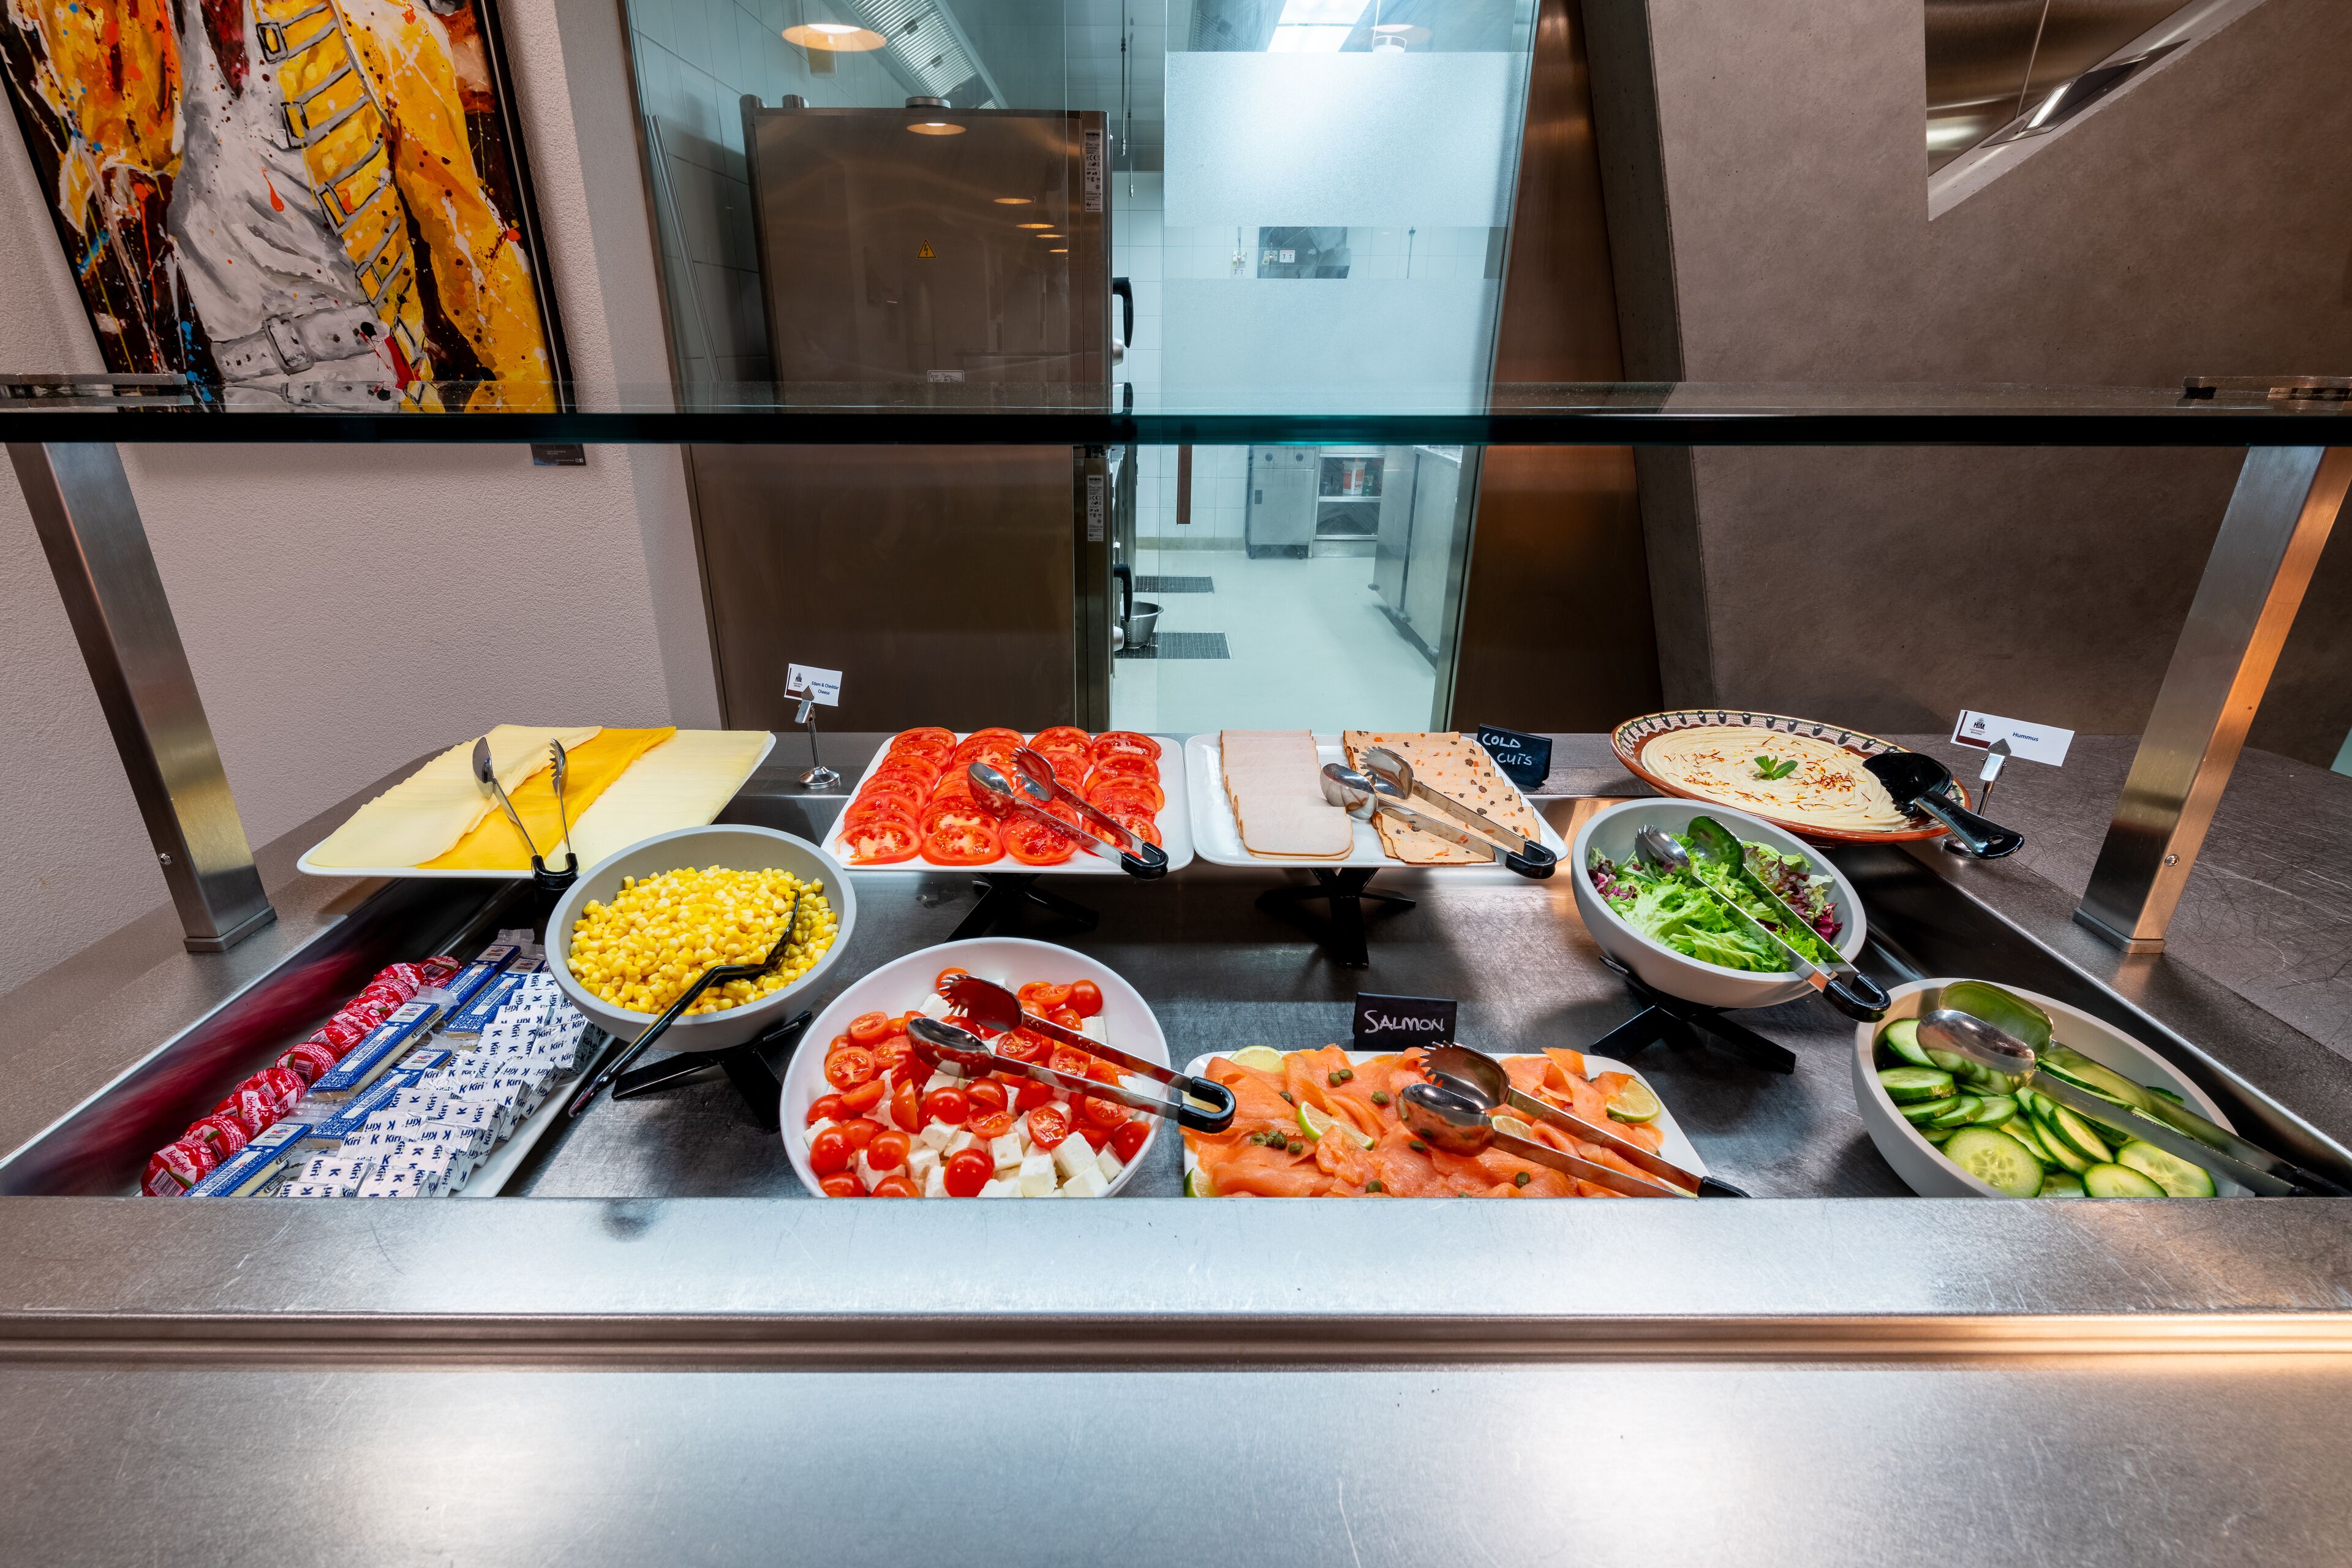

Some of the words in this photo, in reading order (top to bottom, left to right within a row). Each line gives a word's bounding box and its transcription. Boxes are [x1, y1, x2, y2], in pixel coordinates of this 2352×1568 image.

[1482, 733, 1521, 748] COLD
[2013, 732, 2039, 742] Hummus
[398, 965, 418, 986] Babybel
[1364, 1009, 1445, 1033] SALMON
[511, 1024, 521, 1038] Kiri
[490, 1042, 500, 1055] Kiri
[550, 1041, 564, 1050] Kiri
[469, 1082, 485, 1091] Kiri
[425, 1096, 437, 1111] Kiri
[245, 1095, 258, 1128] Babybel
[436, 1105, 448, 1120] Kiri
[472, 1107, 484, 1123] Kiri
[344, 1136, 361, 1147] Kiri
[371, 1134, 380, 1145] K
[421, 1131, 437, 1141] Kiri
[432, 1144, 443, 1159] Kiri
[166, 1150, 192, 1174] Babybel
[310, 1160, 323, 1177] Kiri
[328, 1169, 342, 1177] K
[349, 1163, 364, 1180] Kiri
[374, 1165, 389, 1182] Kiri
[392, 1174, 405, 1183] K
[300, 1187, 314, 1196] K
